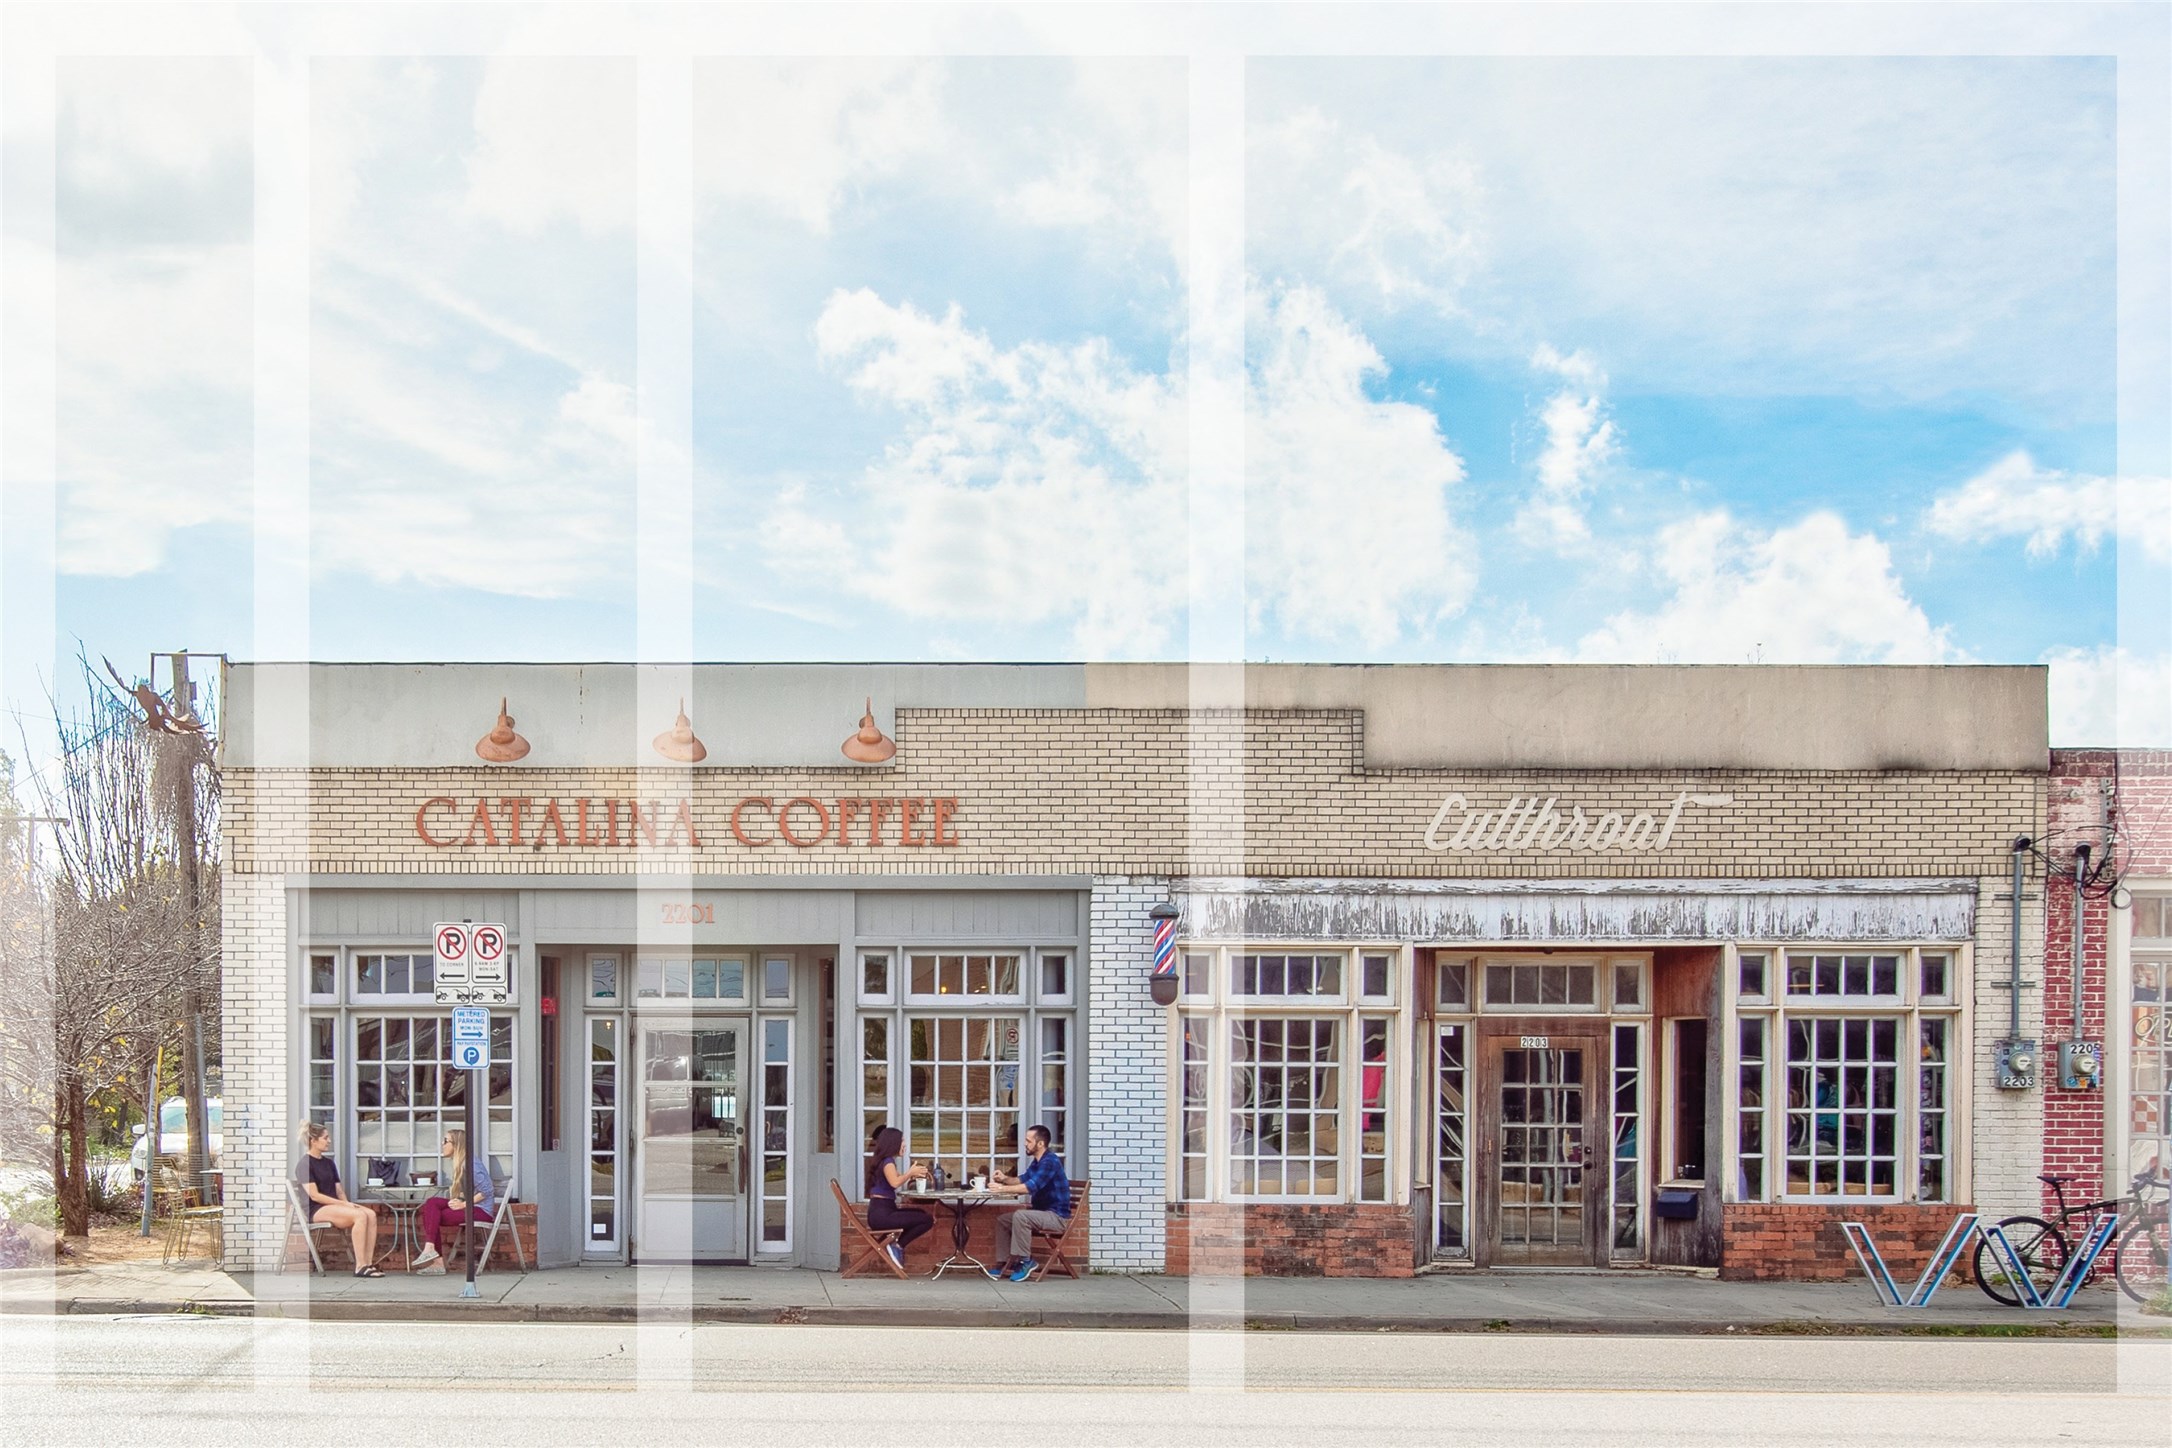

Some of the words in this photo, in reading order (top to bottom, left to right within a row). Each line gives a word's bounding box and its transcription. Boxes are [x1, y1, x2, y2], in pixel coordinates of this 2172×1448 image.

[415, 796, 700, 848] CATALINA
[730, 796, 960, 848] COFFEE
[1422, 790, 1734, 852] Cutthroat
[661, 902, 715, 925] 2201
[1521, 1037, 1548, 1048] 2203
[2003, 1076, 2034, 1087] 2203
